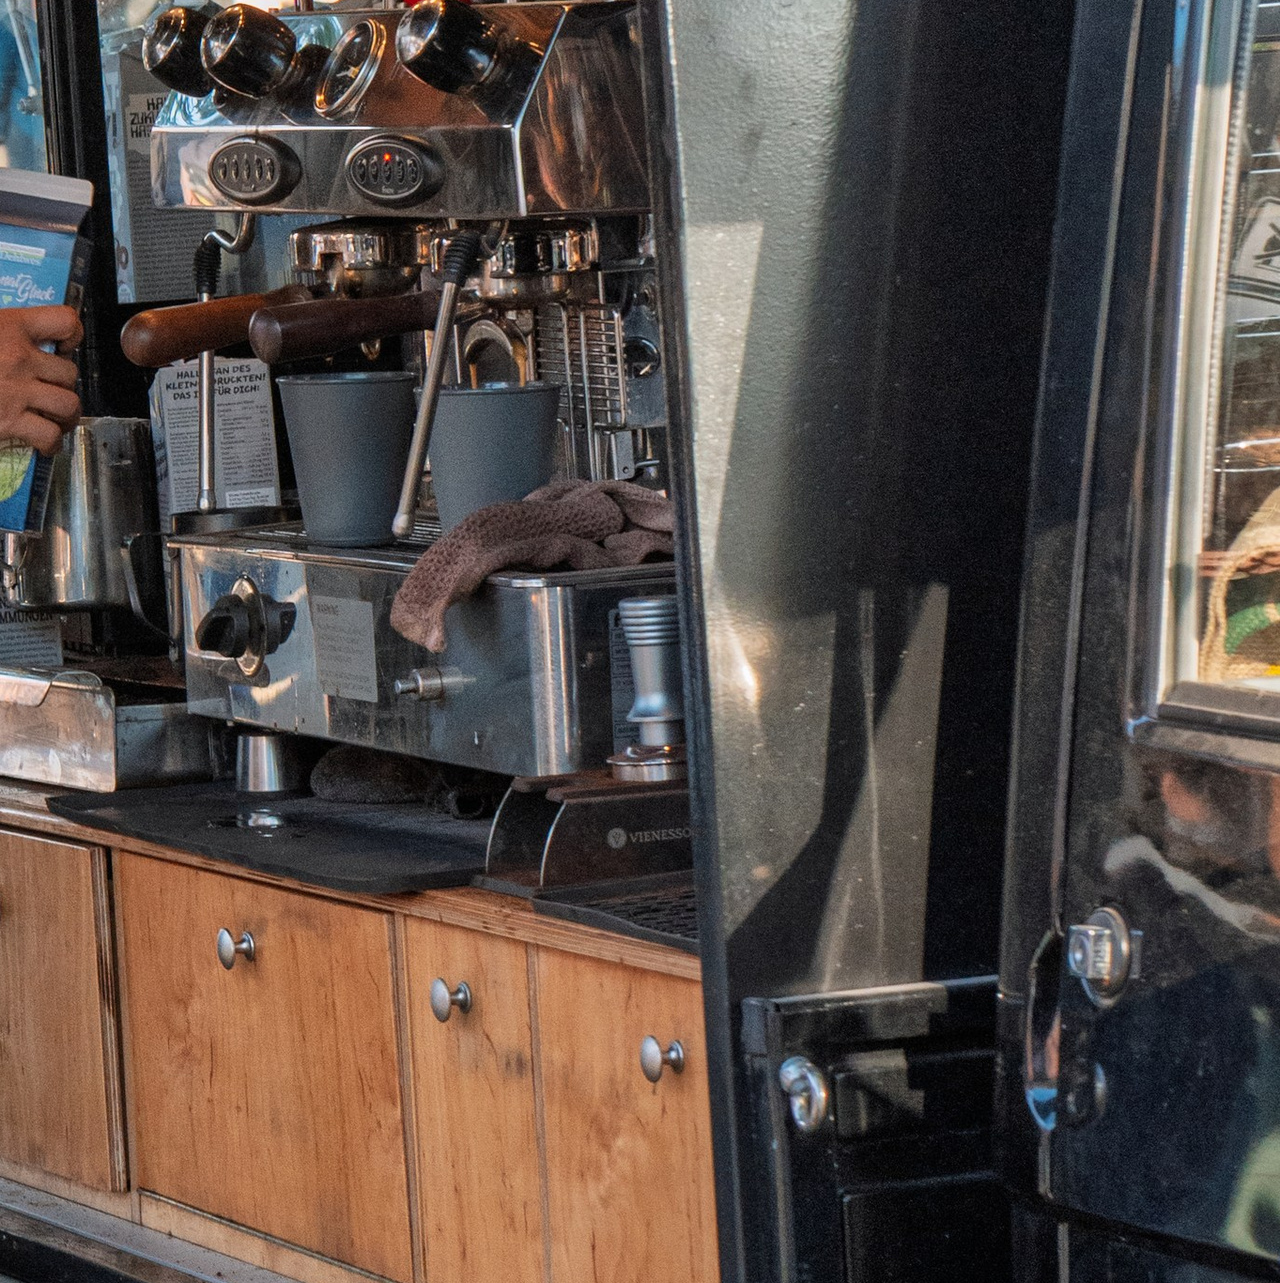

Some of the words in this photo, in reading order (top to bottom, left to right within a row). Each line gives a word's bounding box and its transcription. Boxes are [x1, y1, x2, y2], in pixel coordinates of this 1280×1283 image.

[176, 369, 200, 381] HALL
[232, 364, 252, 374] DES
[173, 392, 192, 401] DAS
